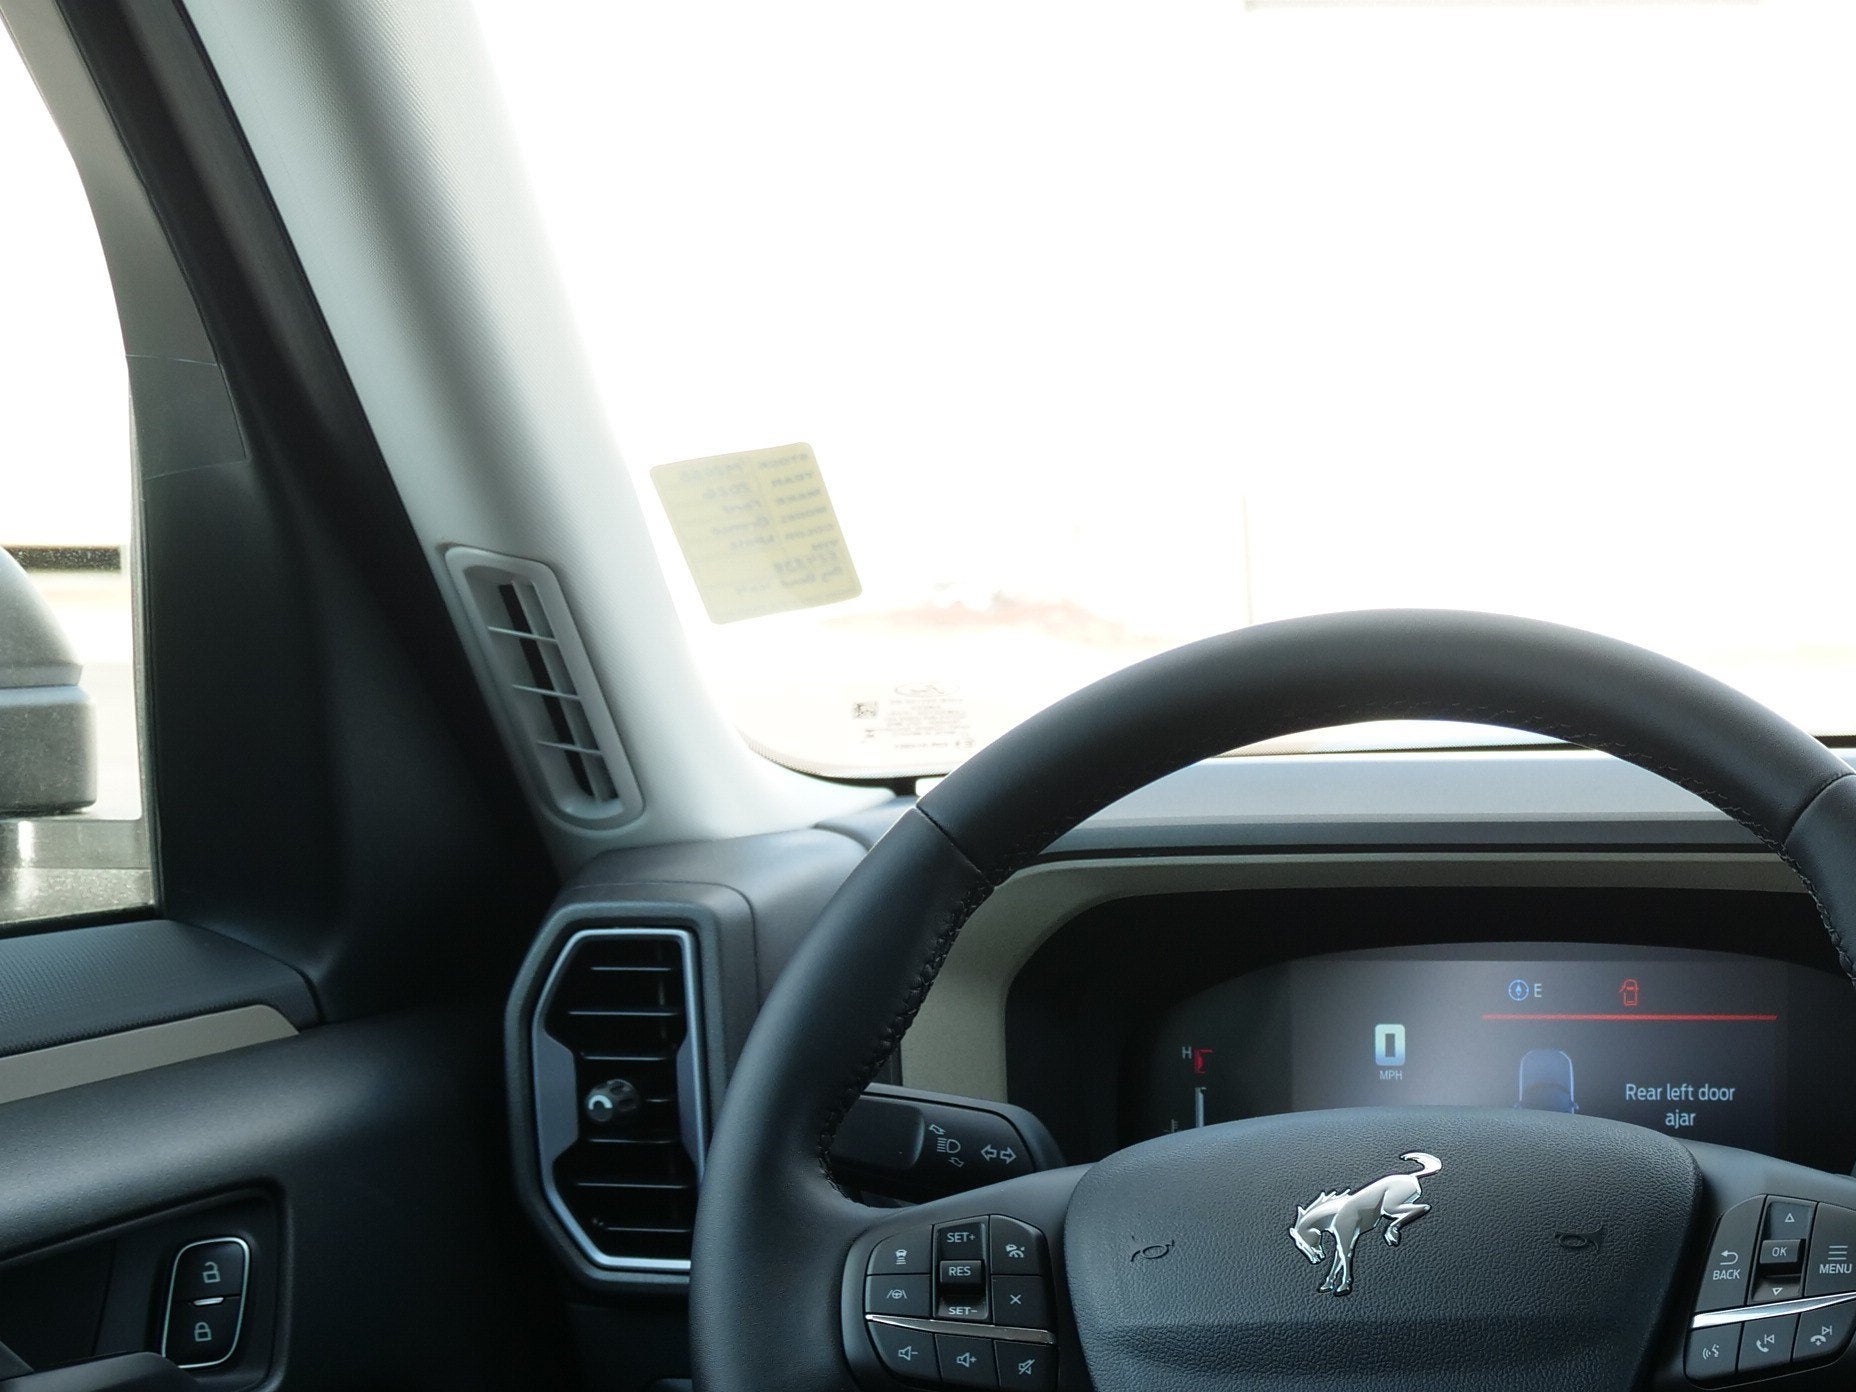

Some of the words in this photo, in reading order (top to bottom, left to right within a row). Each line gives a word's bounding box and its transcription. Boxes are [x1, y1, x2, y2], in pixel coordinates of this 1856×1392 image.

[1182, 1046, 1193, 1059] H
[1379, 1070, 1403, 1081] MPH
[1625, 1083, 1662, 1101] Rear
[1666, 1083, 1695, 1101] left
[1698, 1083, 1736, 1101] door
[1665, 1109, 1696, 1129] ajar
[1772, 1246, 1788, 1258] OK
[948, 1266, 972, 1277] RES
[1712, 1268, 1741, 1281] BACK
[1818, 1263, 1853, 1275] MENU
